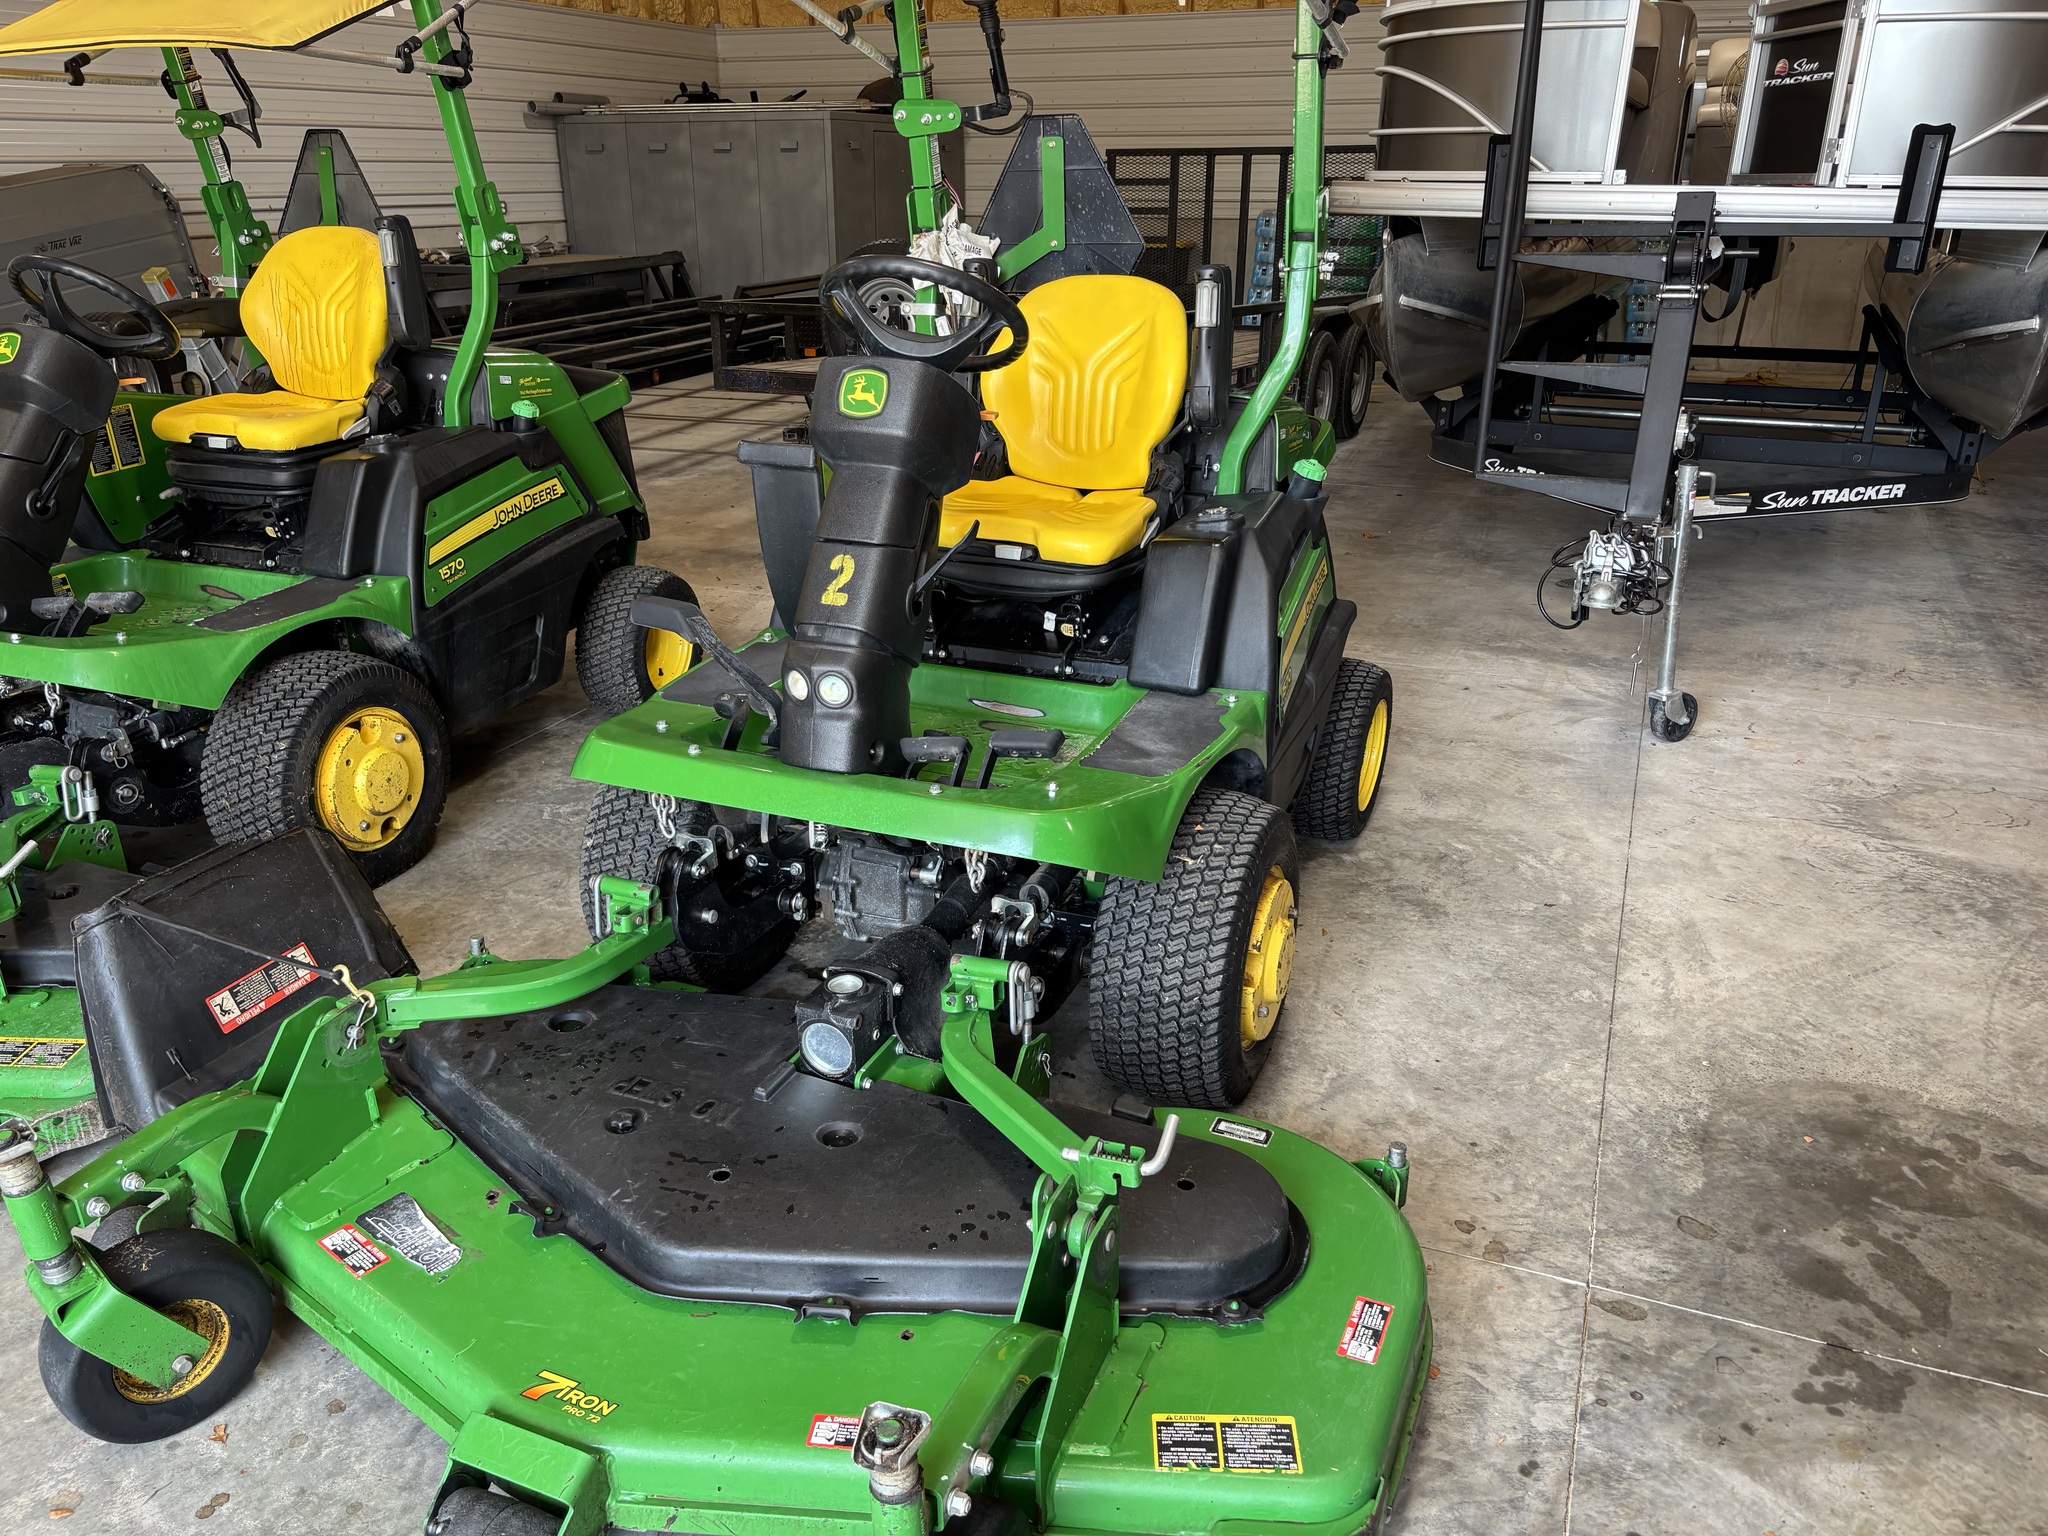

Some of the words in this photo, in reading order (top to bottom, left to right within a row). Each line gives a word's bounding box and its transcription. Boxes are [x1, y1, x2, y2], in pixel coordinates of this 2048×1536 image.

[1789, 58, 1820, 74] Sun
[1763, 71, 1834, 88] TRACKER
[48, 238, 67, 251] TRAC
[69, 234, 82, 247] VAC
[493, 501, 524, 528] JOHN
[523, 484, 560, 511] DEERE
[1755, 490, 1809, 510] Sun
[1811, 483, 1906, 506] TRACKER
[438, 557, 465, 580] 1570
[821, 553, 855, 606] 2
[283, 980, 307, 995] DANGER
[236, 1006, 261, 1025] PELIGRO
[561, 1404, 586, 1417] PRO
[586, 1413, 601, 1424] 72
[833, 1416, 860, 1424] DANGER
